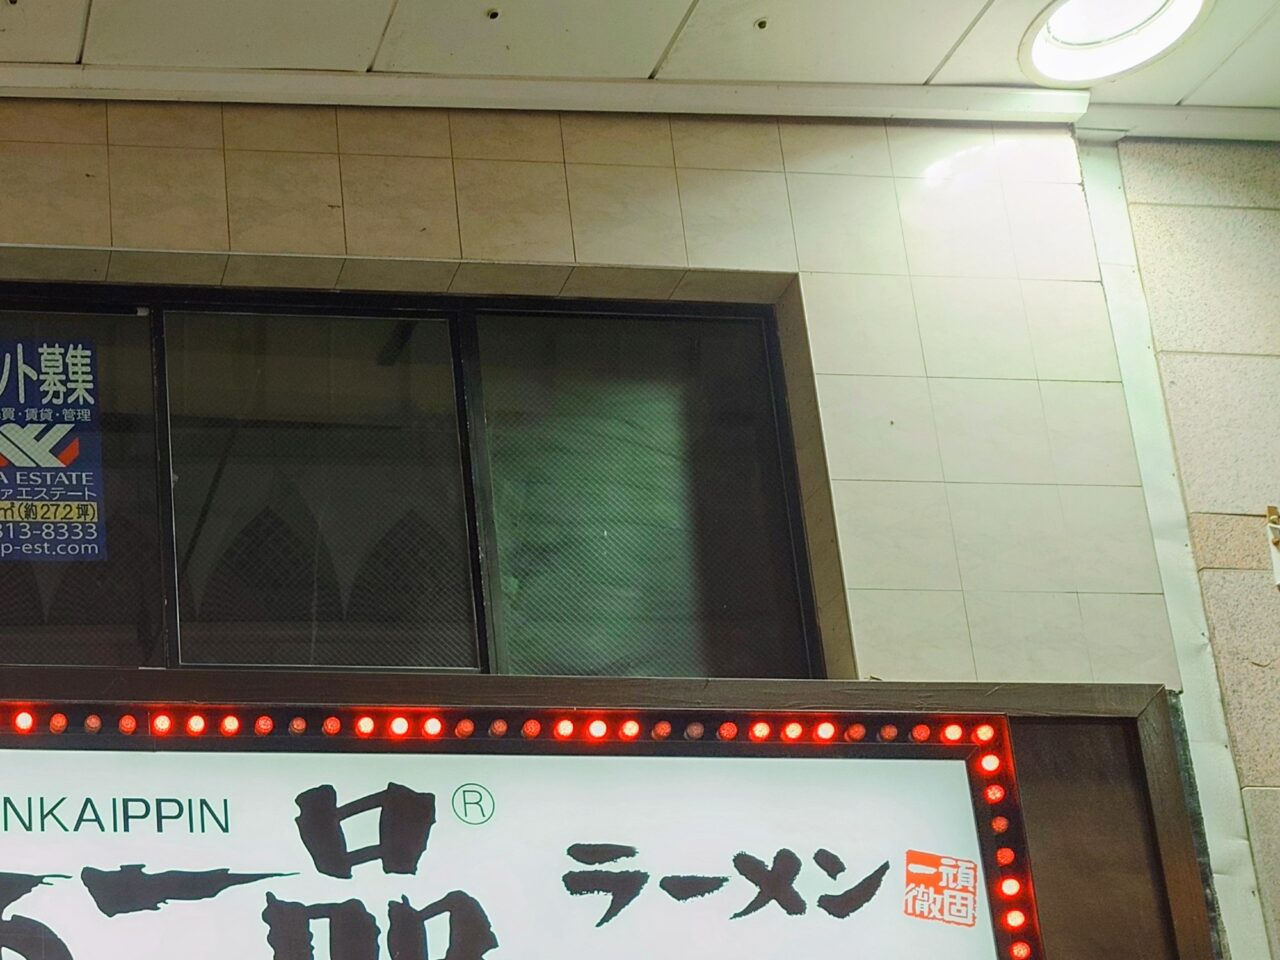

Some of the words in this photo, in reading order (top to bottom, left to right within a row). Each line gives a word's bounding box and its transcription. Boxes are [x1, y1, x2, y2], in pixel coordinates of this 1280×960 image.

[16, 472, 94, 485] ESTATE
[561, 843, 891, 928] ラーメン
